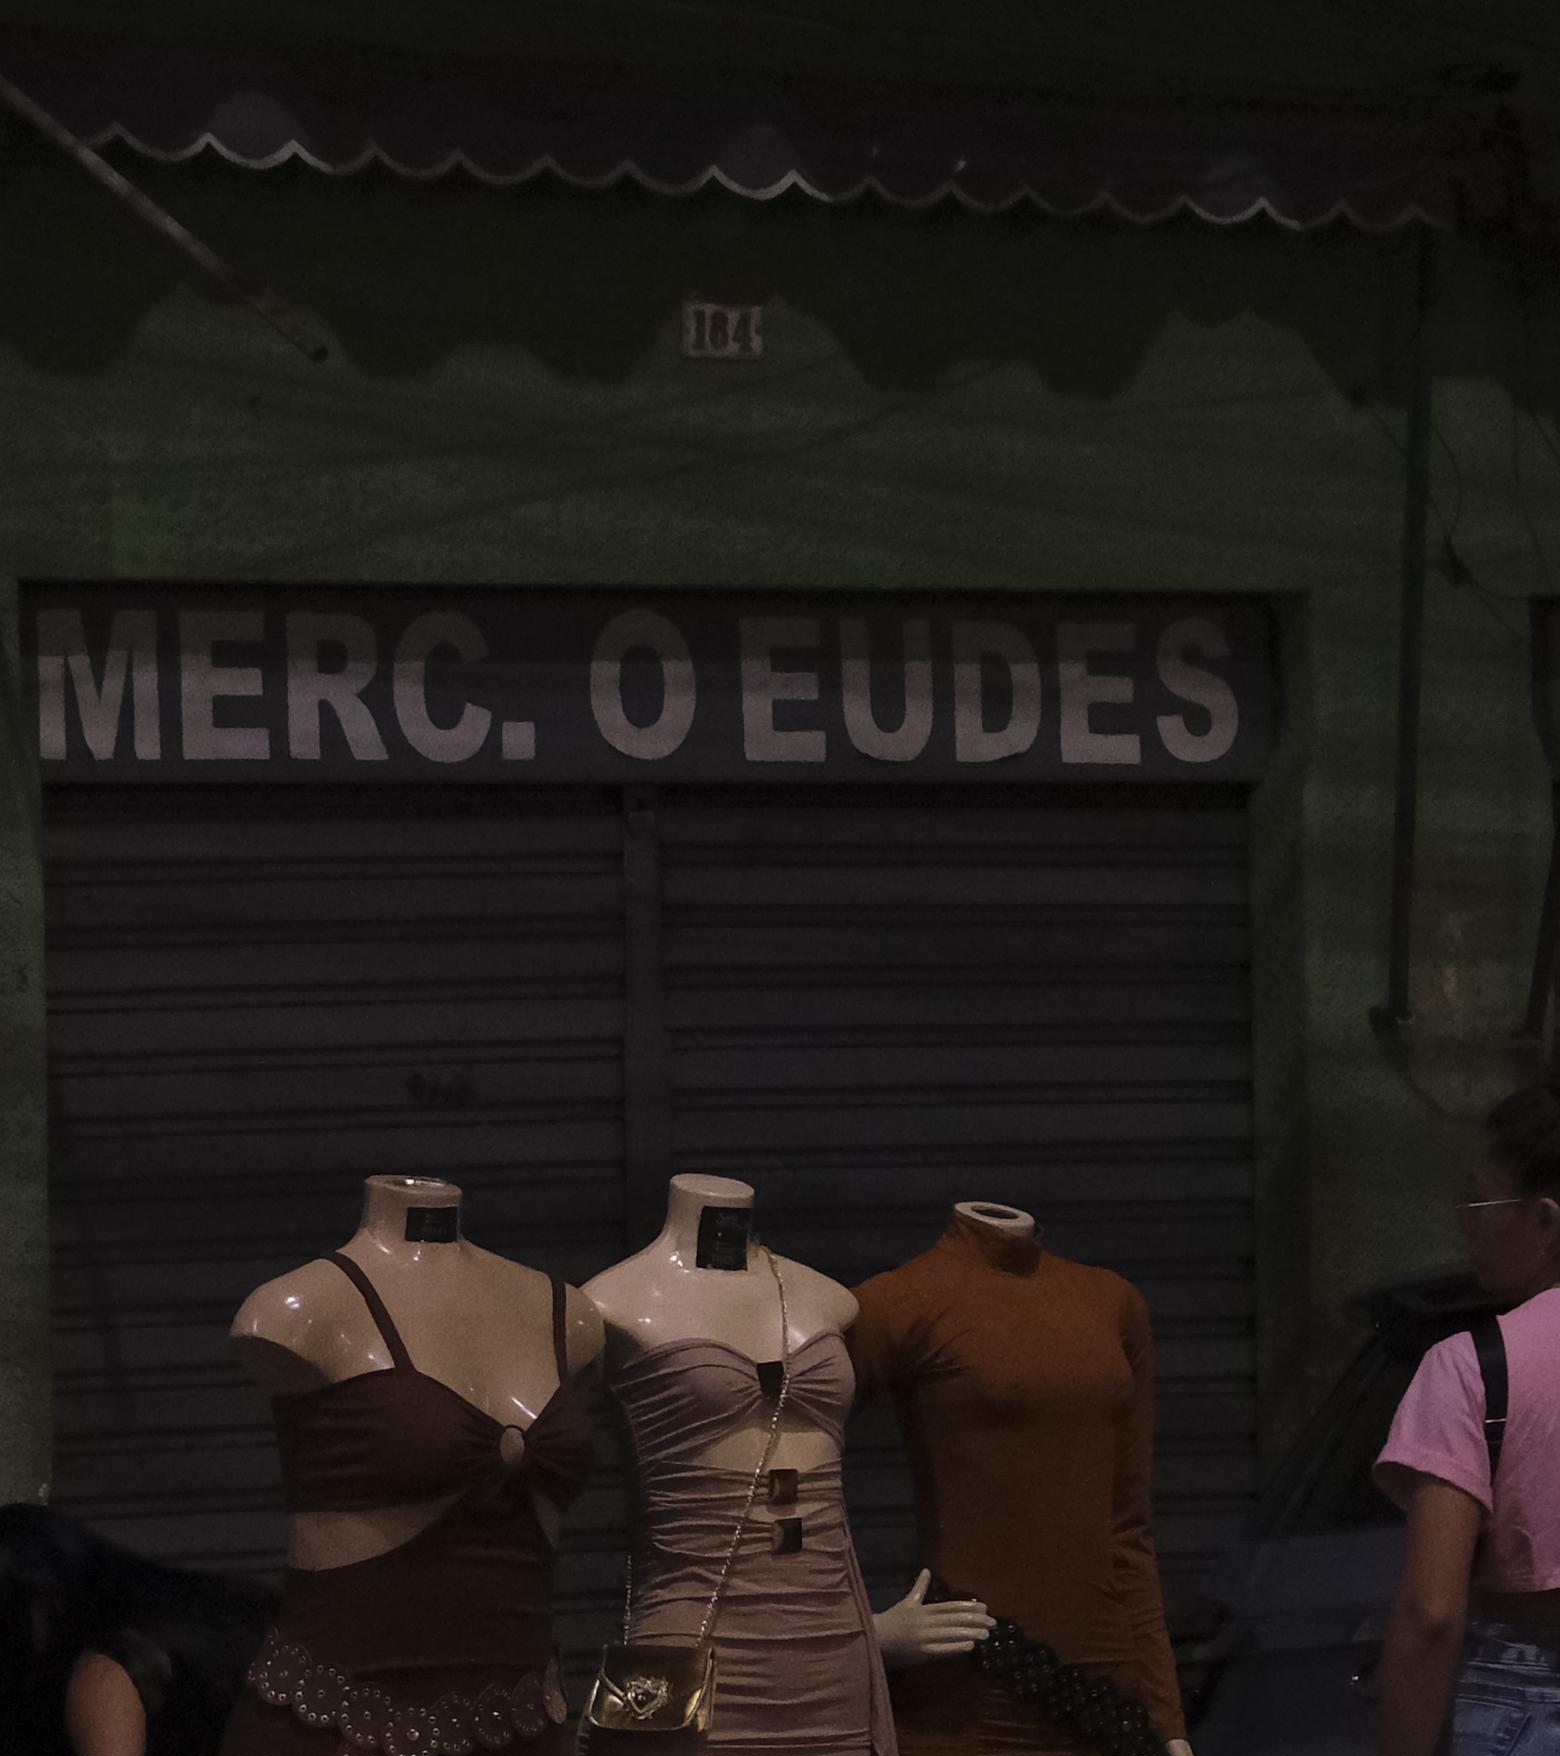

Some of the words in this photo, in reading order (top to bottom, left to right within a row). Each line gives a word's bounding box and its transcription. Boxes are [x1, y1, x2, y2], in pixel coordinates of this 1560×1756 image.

[691, 308, 754, 351] 184
[36, 607, 536, 763] MERC.
[589, 607, 697, 762] O
[741, 615, 1241, 765] EUDES
